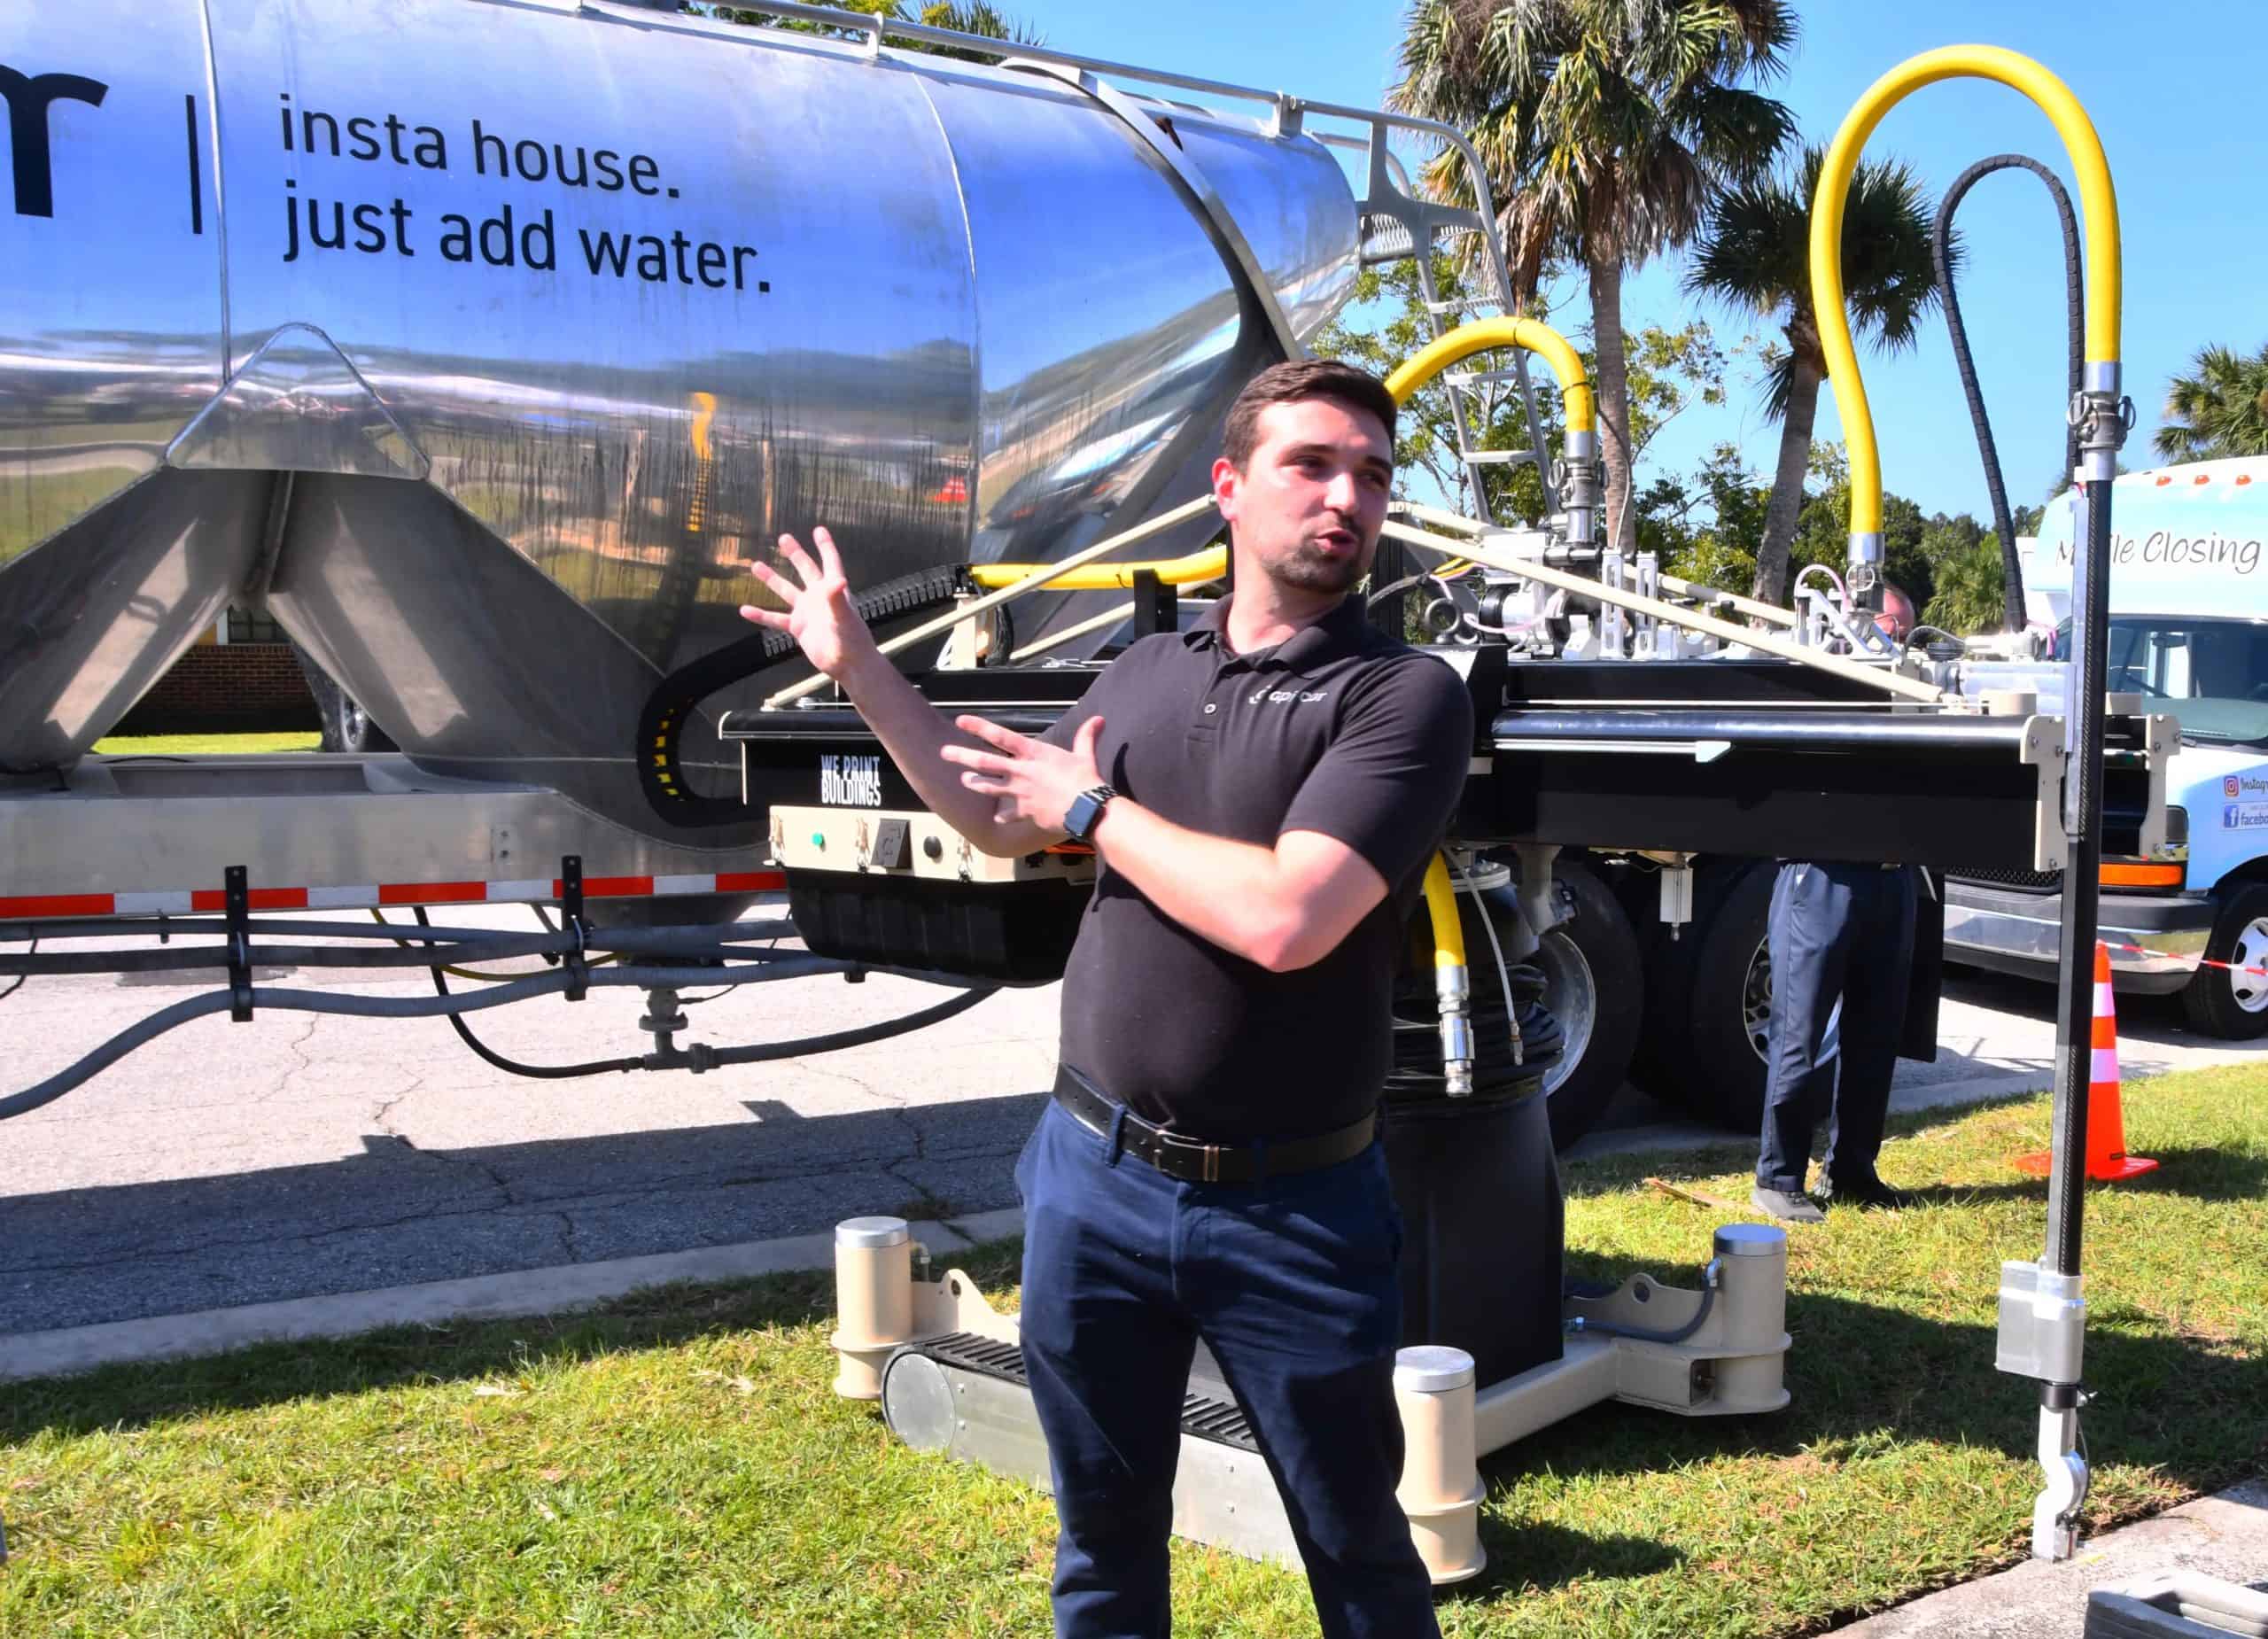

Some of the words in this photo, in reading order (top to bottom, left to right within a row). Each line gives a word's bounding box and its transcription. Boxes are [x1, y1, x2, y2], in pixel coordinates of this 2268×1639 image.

[279, 92, 447, 170] insta
[472, 119, 680, 198] house.
[283, 179, 415, 262] just
[439, 204, 556, 271] add
[579, 229, 771, 292] water.
[2143, 532, 2261, 574] Closing
[821, 755, 840, 780] WE
[843, 755, 880, 781] PRINT
[821, 776, 882, 806] BUILDINGS
